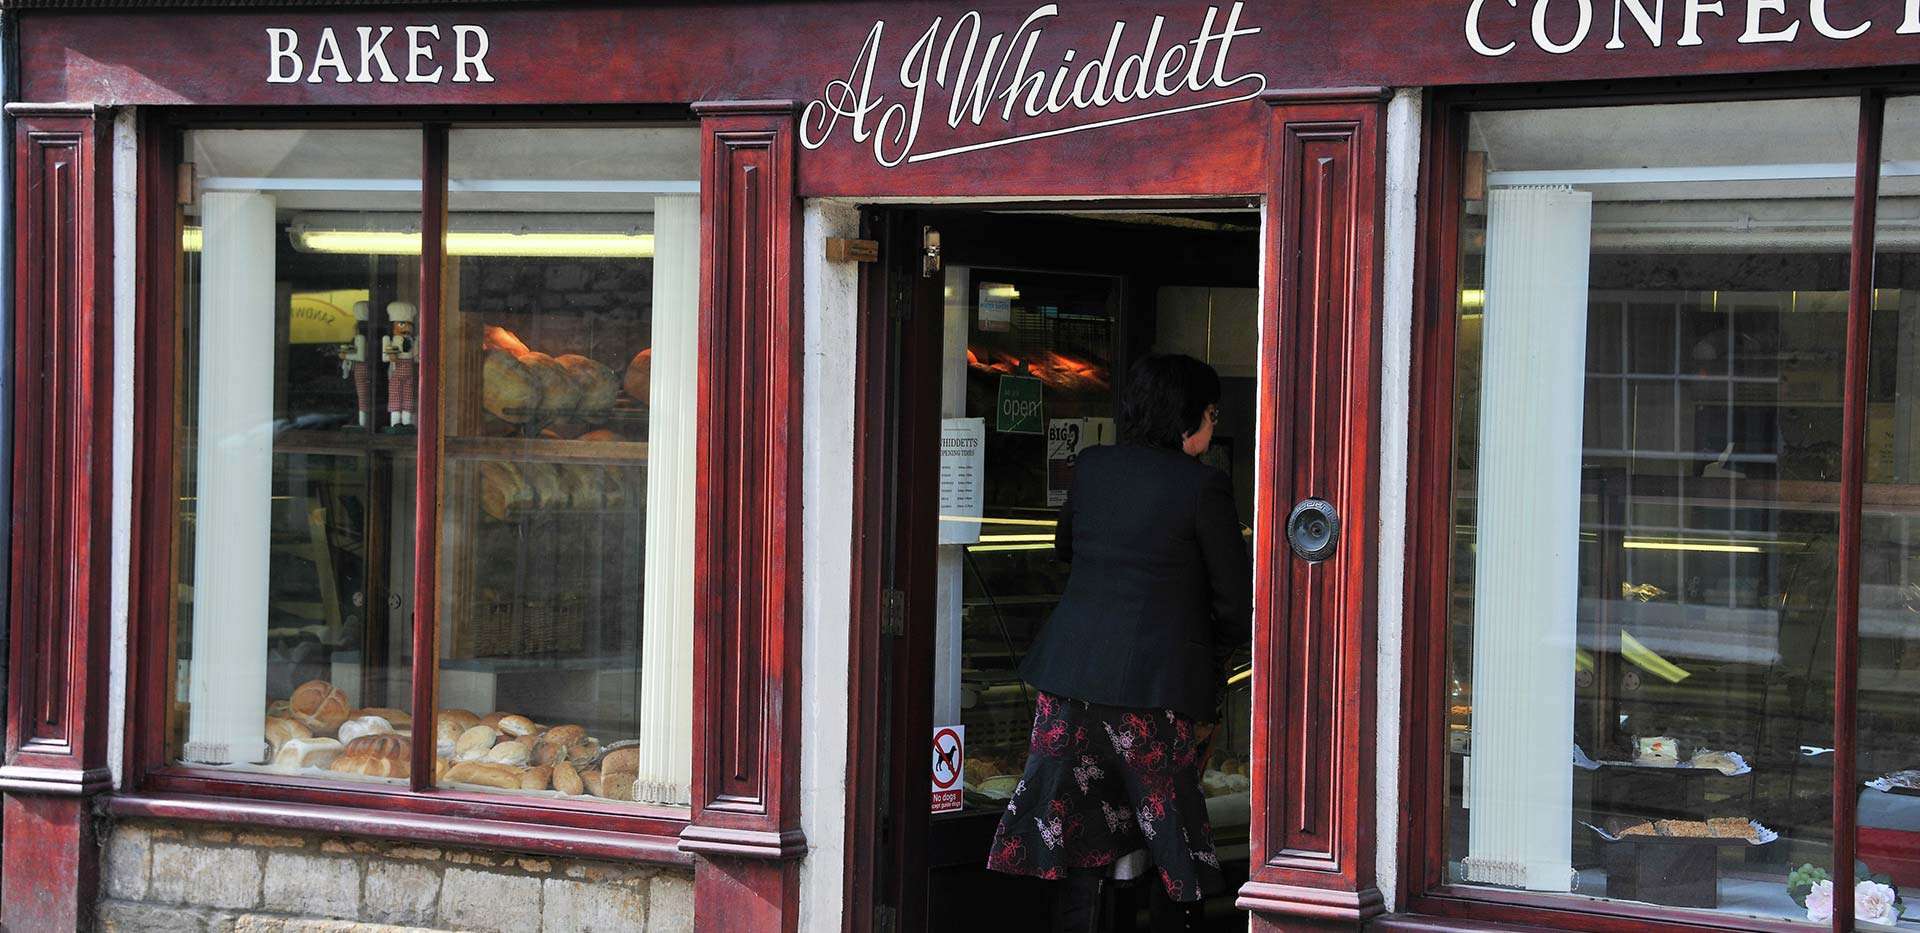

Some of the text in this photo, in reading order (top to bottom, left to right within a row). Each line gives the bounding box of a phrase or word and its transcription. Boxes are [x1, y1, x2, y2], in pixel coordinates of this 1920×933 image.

[265, 24, 495, 84] BAKER
[936, 1, 1264, 128] Whiddett
[1003, 399, 1038, 421] open
[1049, 427, 1067, 441] BIG
[940, 438, 978, 448] HIDDETTS
[940, 449, 960, 457] PENING
[933, 793, 957, 803] No dogs
